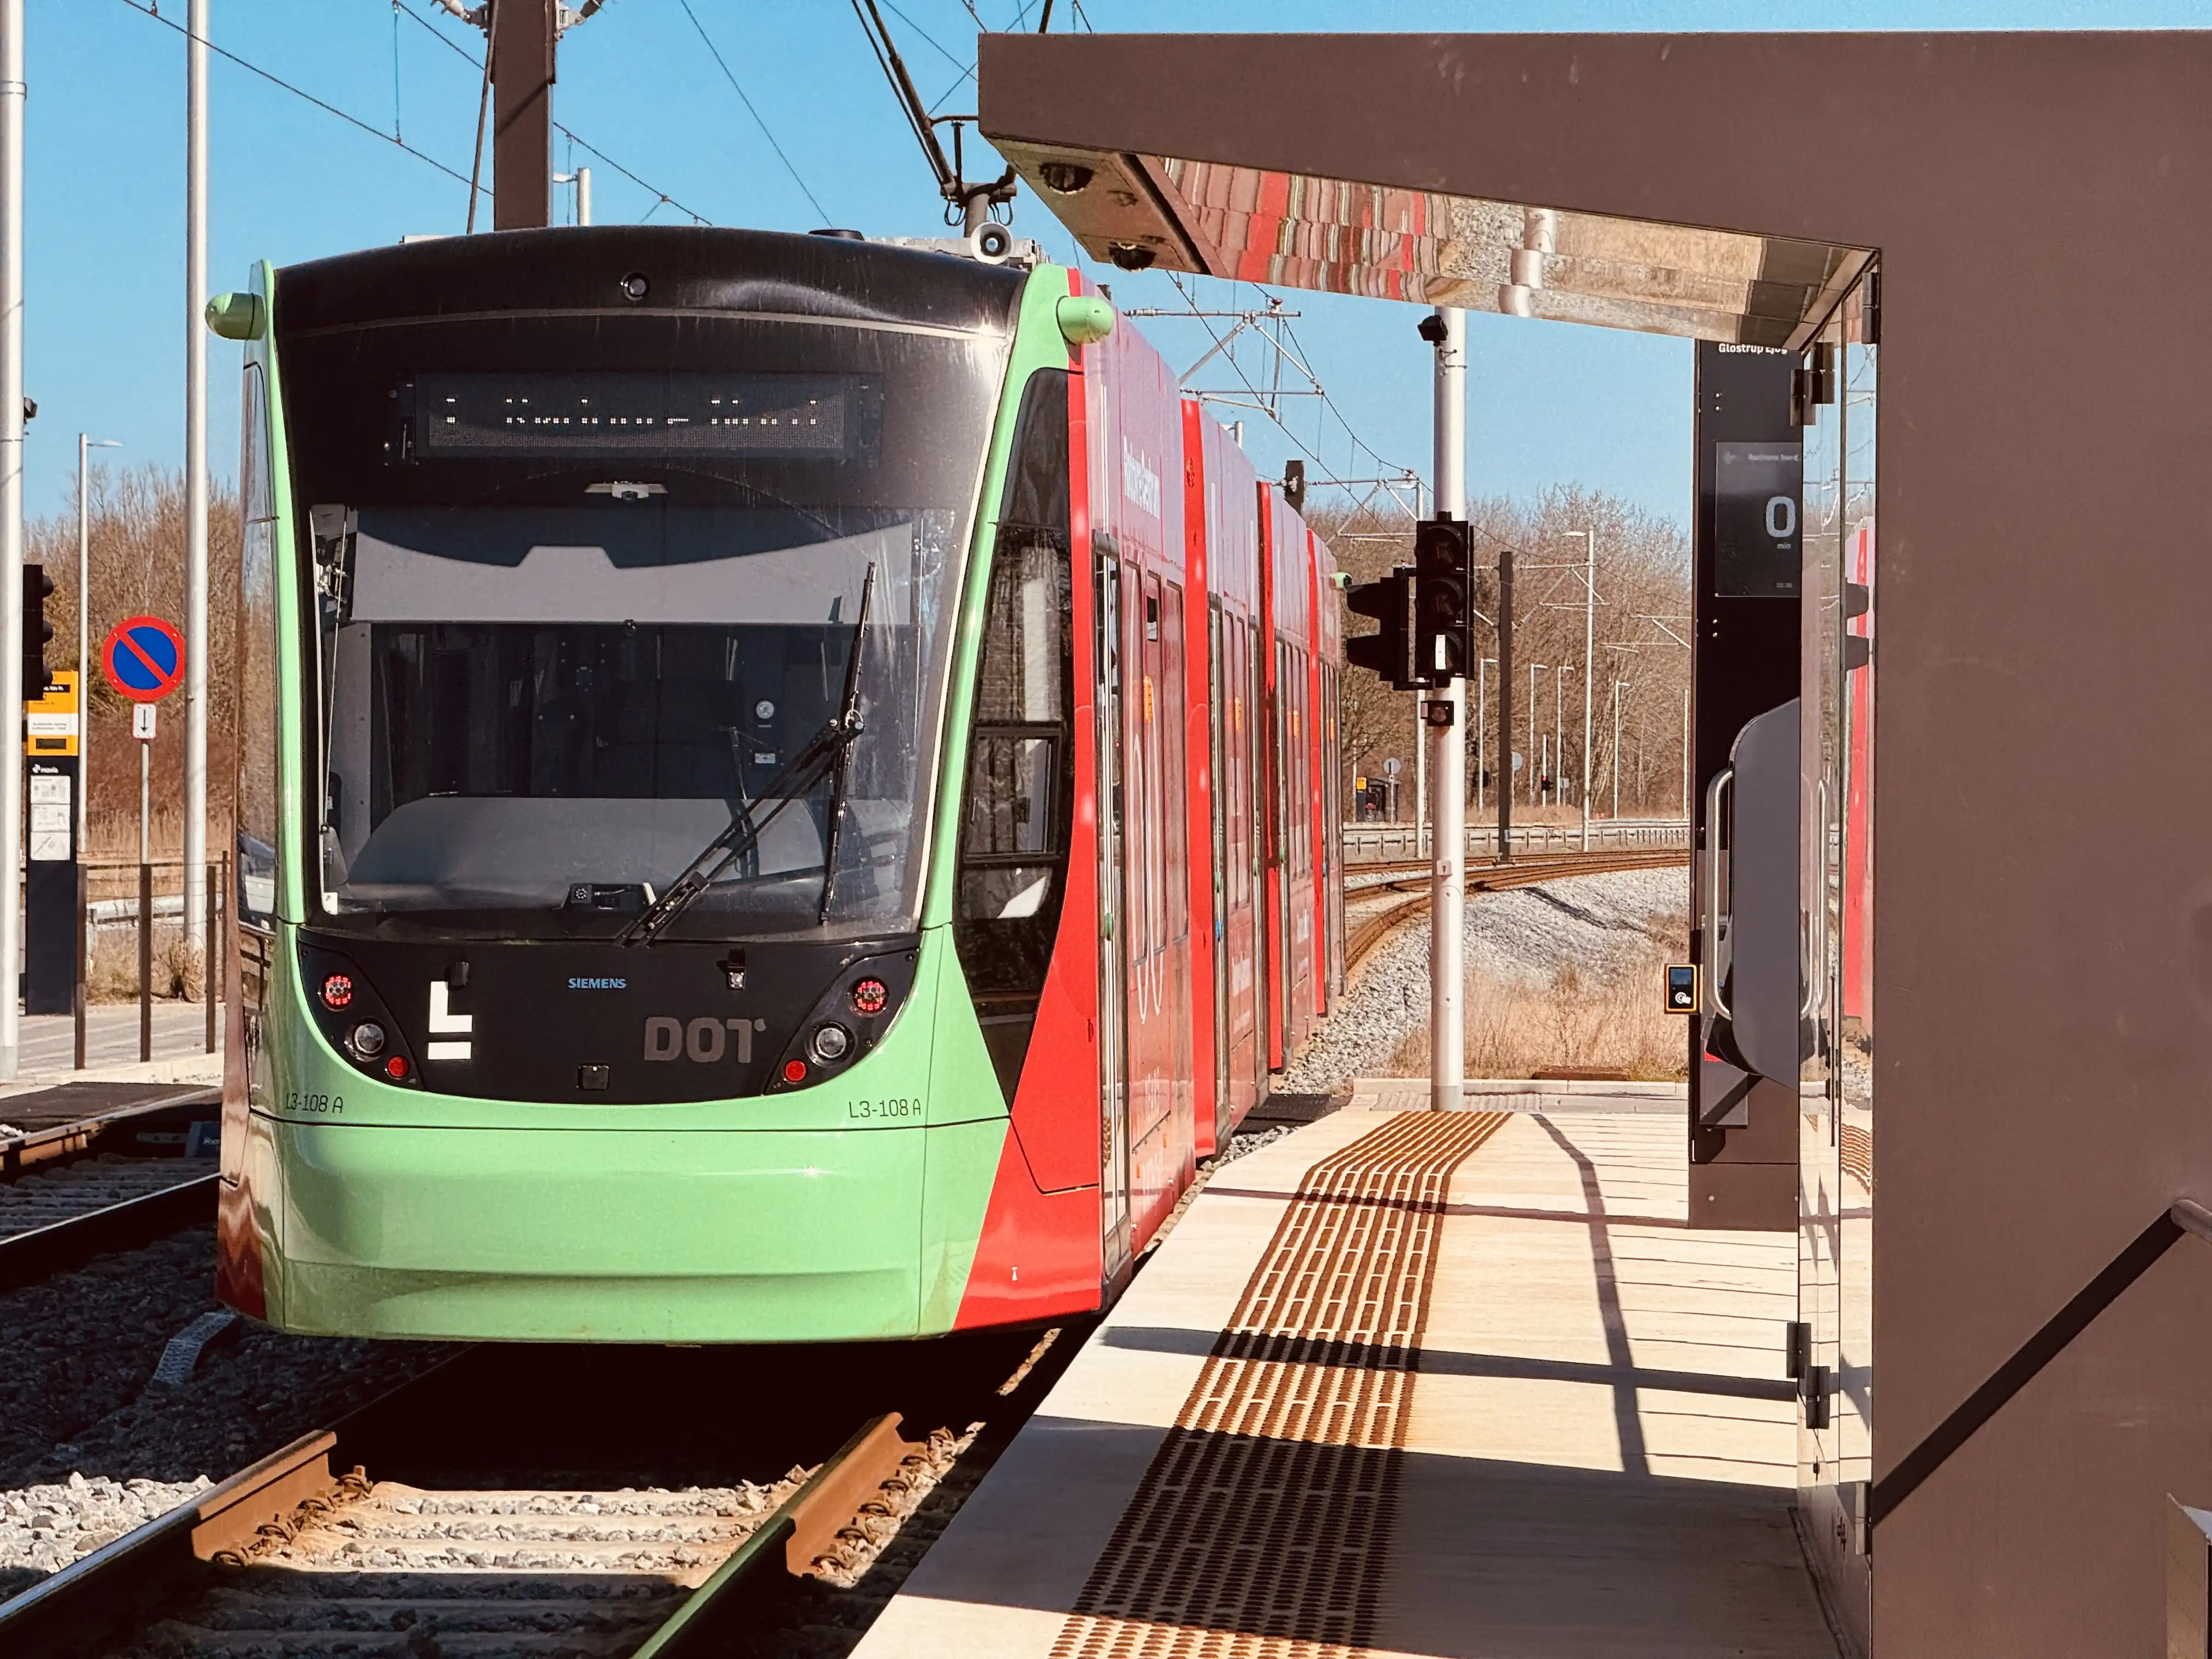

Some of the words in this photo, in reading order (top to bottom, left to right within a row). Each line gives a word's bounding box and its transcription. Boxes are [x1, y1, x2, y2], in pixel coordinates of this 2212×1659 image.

[1718, 343, 1763, 355] Glostrup
[1766, 496, 1795, 537] 0
[568, 978, 627, 989] SIEMENS
[286, 1092, 329, 1113] L3-108
[331, 1096, 343, 1114] A
[848, 1098, 909, 1118] L3-108
[912, 1098, 921, 1116] A
